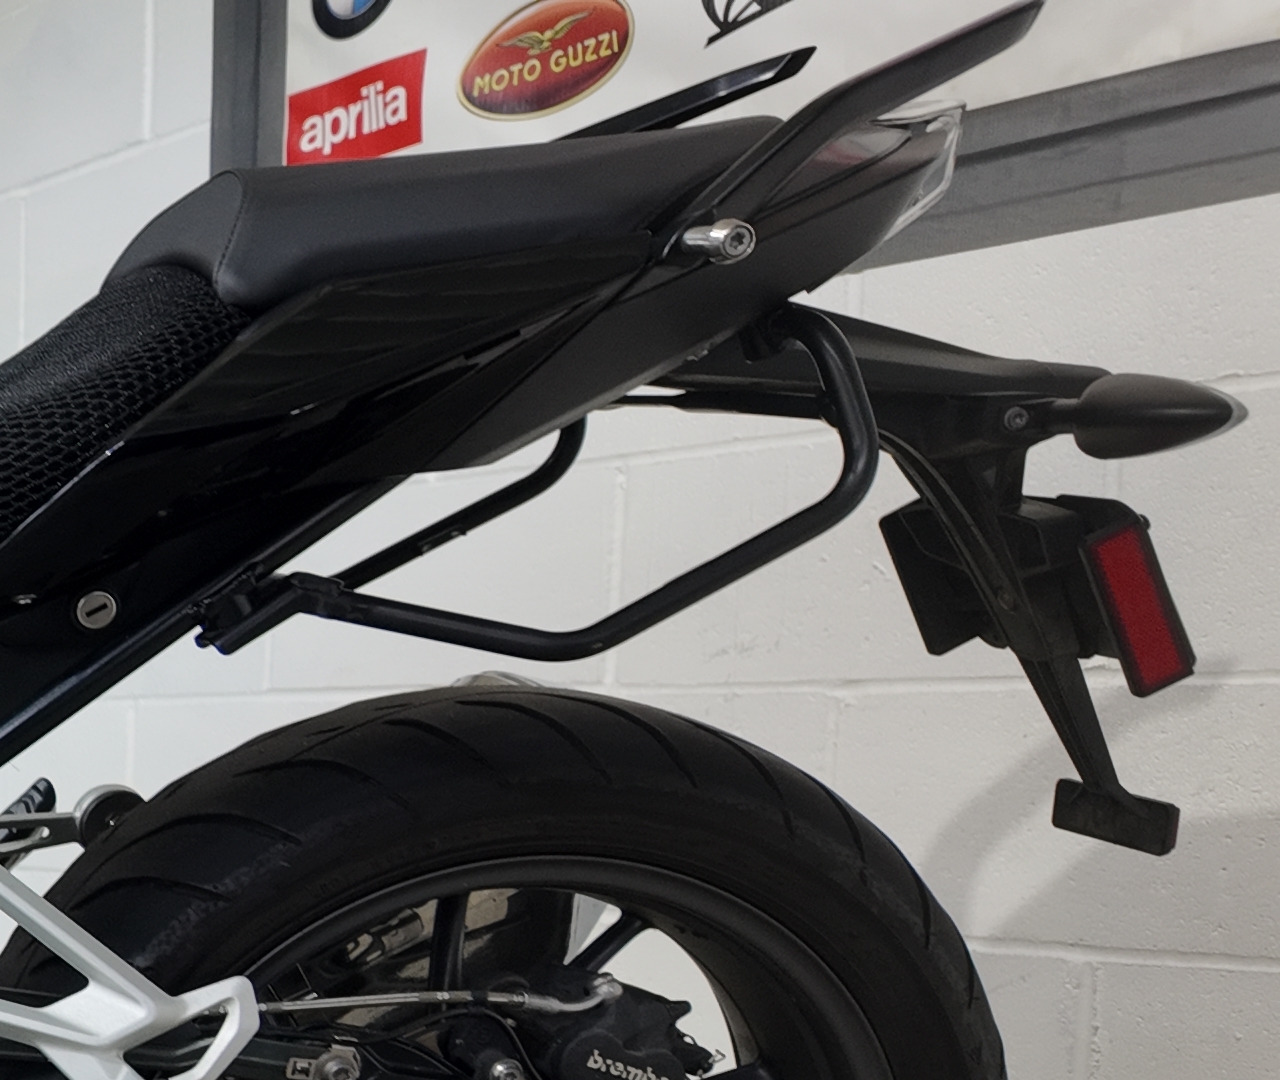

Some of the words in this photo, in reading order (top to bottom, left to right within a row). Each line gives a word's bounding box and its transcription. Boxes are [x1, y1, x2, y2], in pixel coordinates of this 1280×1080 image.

[472, 58, 542, 97] MOTO
[549, 29, 619, 73] GUZZI
[299, 80, 408, 156] aprilia
